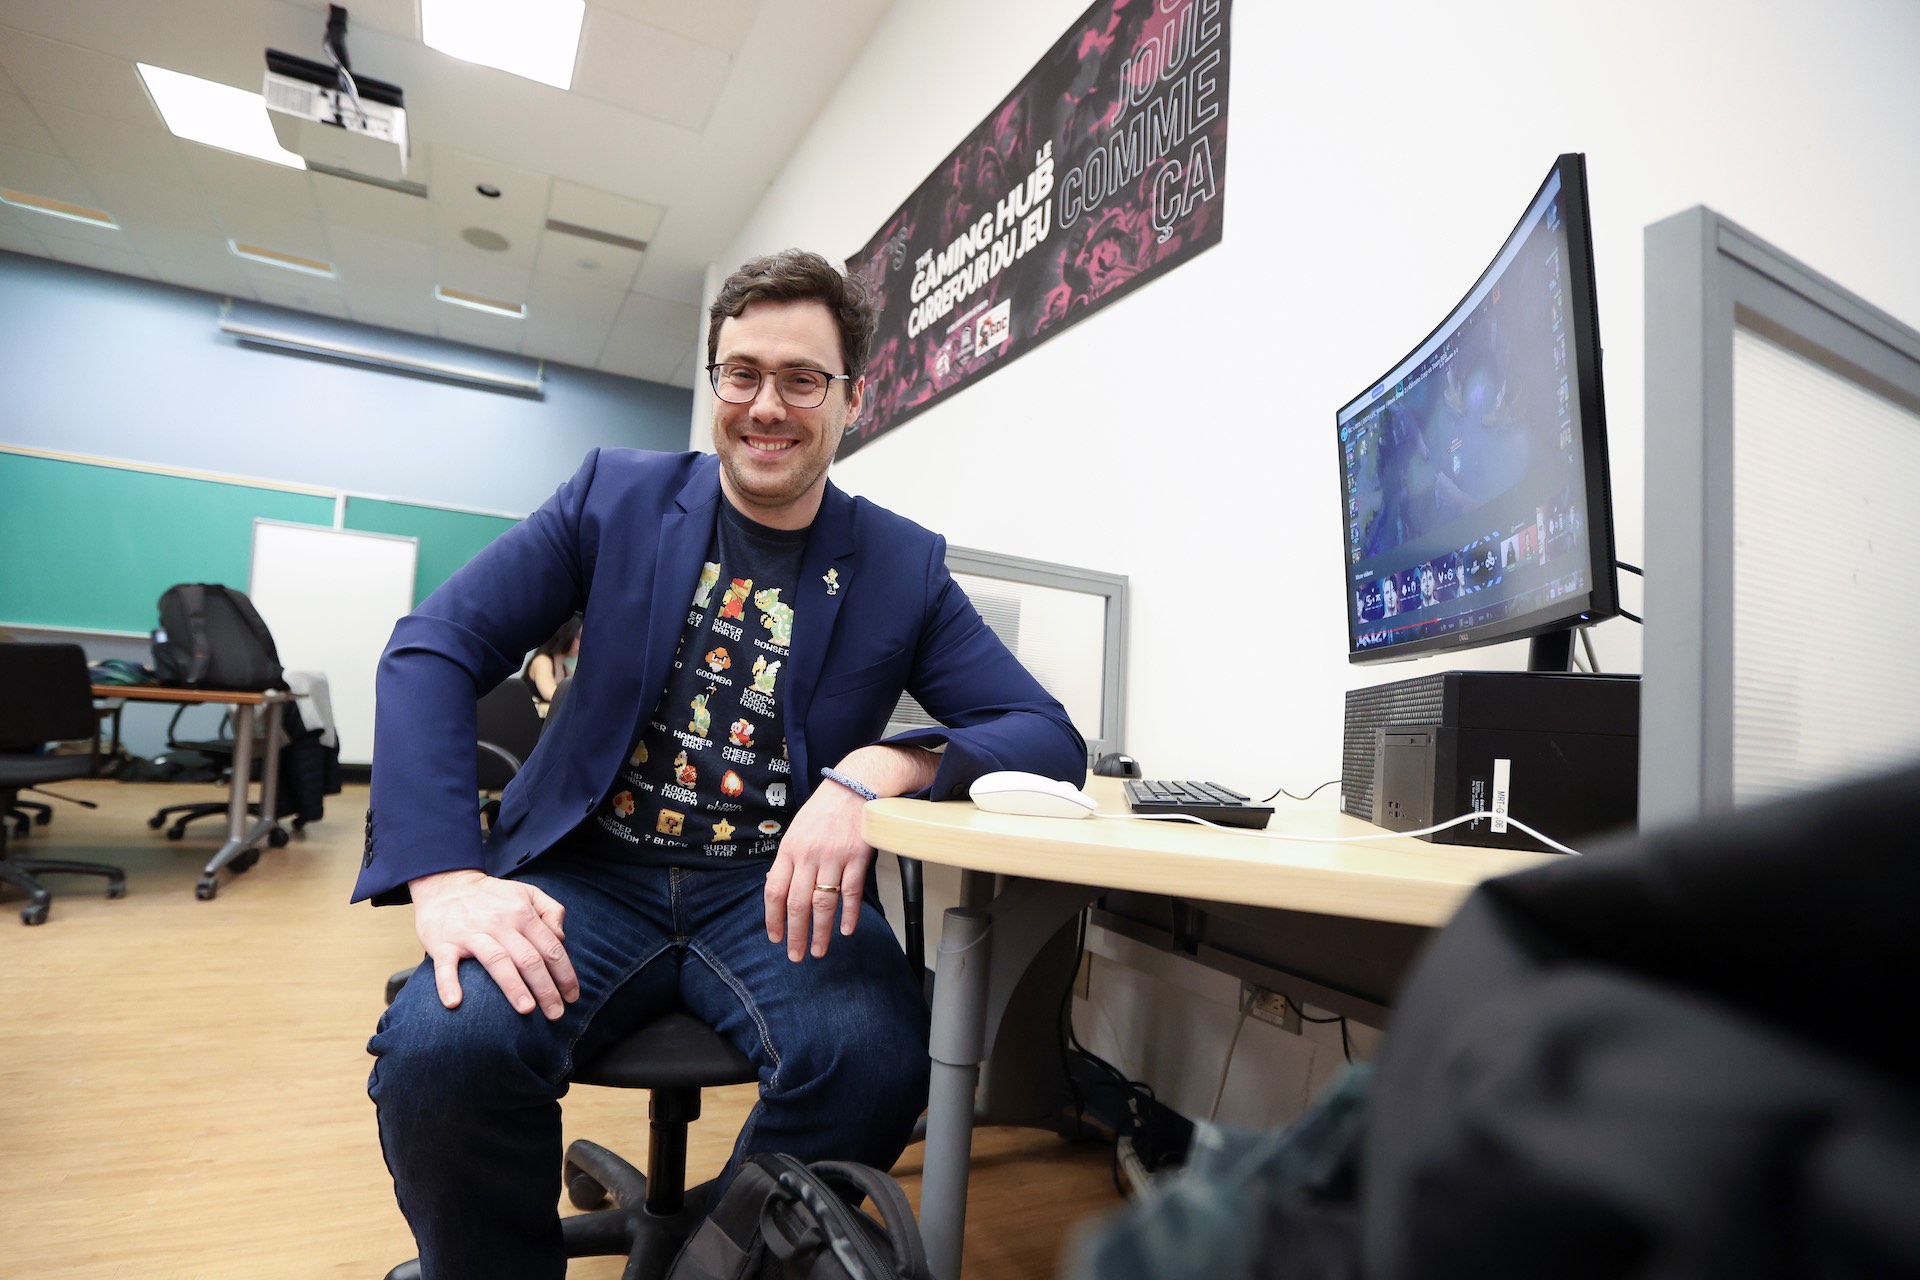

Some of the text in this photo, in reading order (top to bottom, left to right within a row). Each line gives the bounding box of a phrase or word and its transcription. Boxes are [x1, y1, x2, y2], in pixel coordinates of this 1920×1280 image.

[1110, 0, 1221, 128] JOUE
[1059, 49, 1220, 229] COMME
[1035, 139, 1052, 167] LE
[1152, 136, 1215, 244] ÇA
[910, 212, 994, 303] GAMING
[995, 157, 1054, 236] HUB
[908, 251, 990, 339] CARREFOUR
[989, 227, 1017, 279] DU
[1015, 198, 1052, 259] JEU
[915, 248, 933, 272] THE
[711, 624, 741, 642] MARIO
[713, 618, 743, 636] SUPER
[695, 668, 732, 687] GOOMBA
[743, 687, 775, 706] KOOPA
[739, 697, 775, 719] TROOPA
[673, 729, 713, 748] HAMMER
[681, 740, 703, 751] BRO
[721, 752, 755, 766] CHEEP
[722, 745, 756, 759] CHEEP
[660, 788, 698, 807] TROOPA
[663, 782, 697, 800] KOOPA
[703, 843, 738, 852] SUPER
[705, 849, 734, 857] STAR
